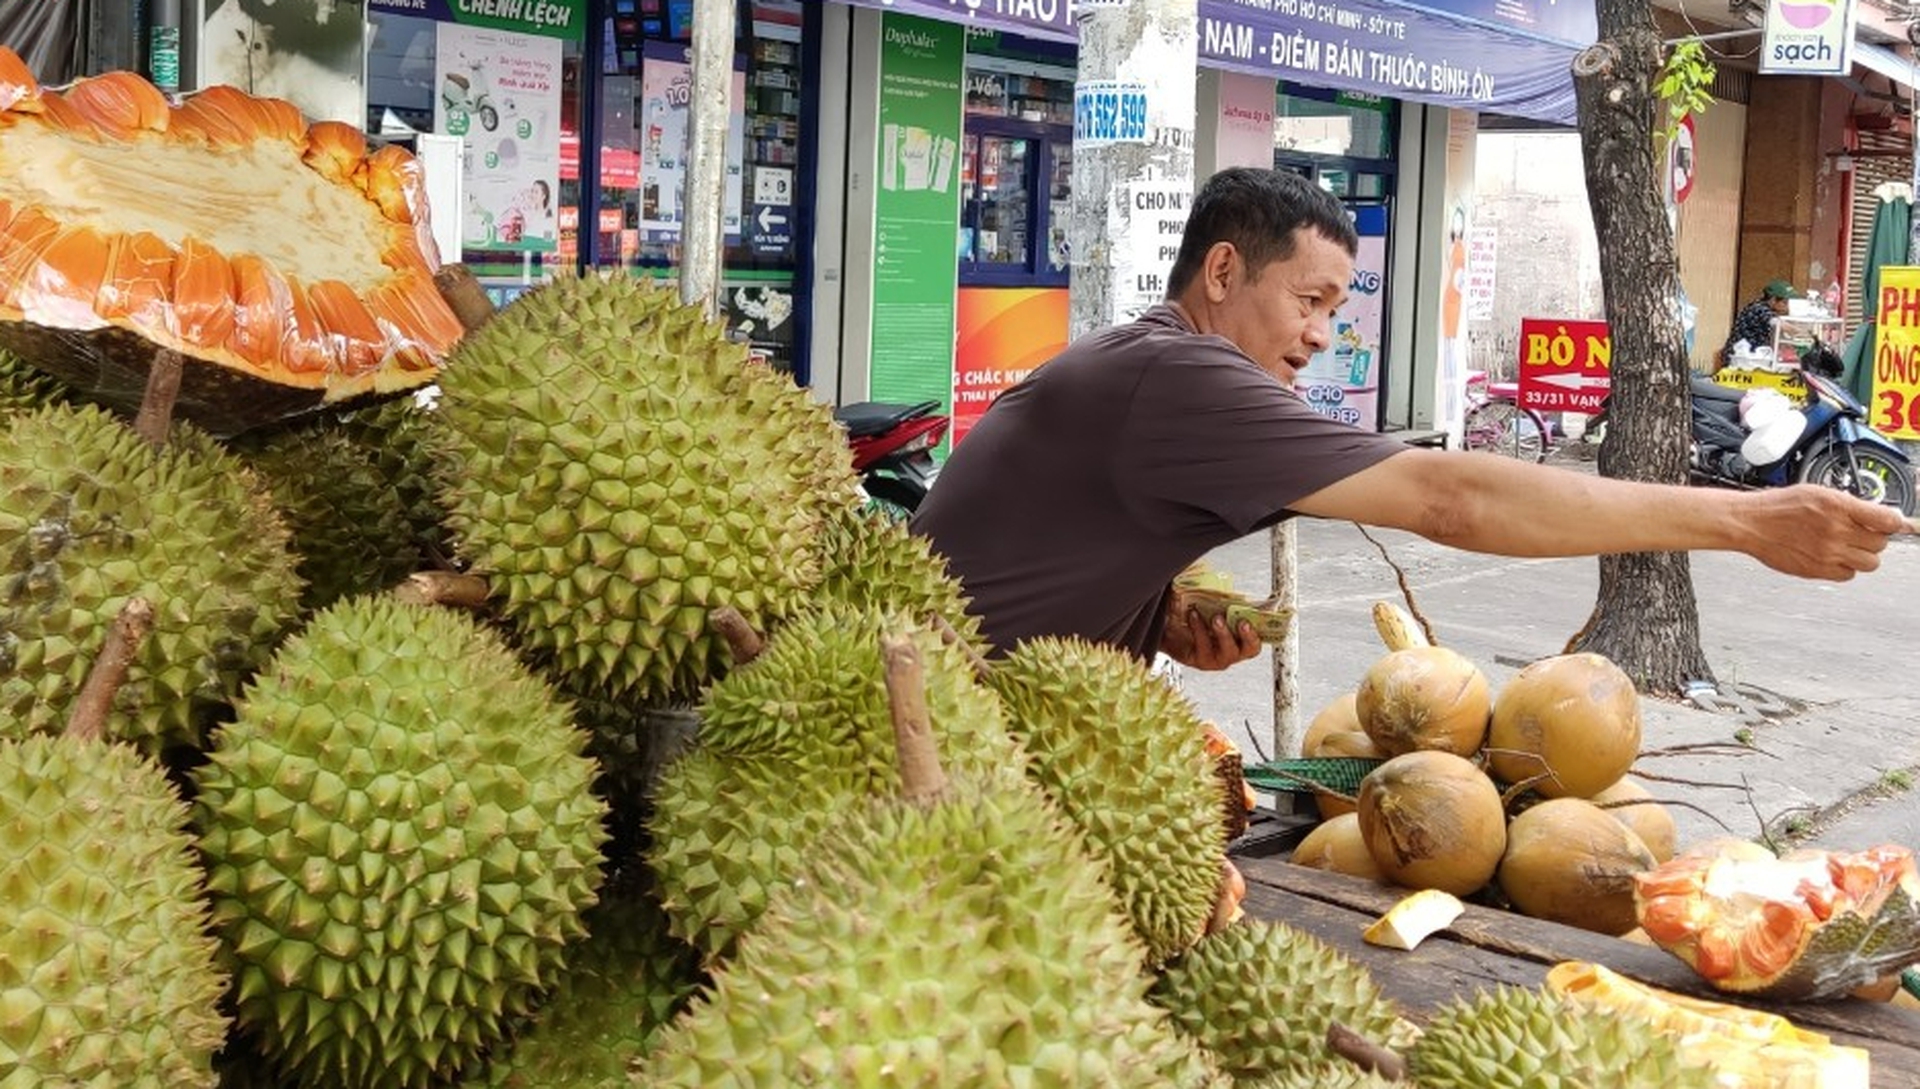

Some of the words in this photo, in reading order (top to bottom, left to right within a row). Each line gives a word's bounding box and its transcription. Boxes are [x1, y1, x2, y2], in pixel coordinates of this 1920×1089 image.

[1337, 9, 1363, 30] MINH
[1205, 18, 1254, 59] NAM
[1271, 27, 1320, 72] ĐIỂM
[1324, 38, 1364, 79] BÁN
[1773, 35, 1831, 65] sạch
[1136, 191, 1166, 210] CHO
[1137, 274, 1163, 291] LH:
[1526, 325, 1575, 367] BÒ
[1307, 385, 1344, 402] CHO
[1525, 391, 1565, 405] 33/31
[1569, 394, 1600, 410] VẠN
